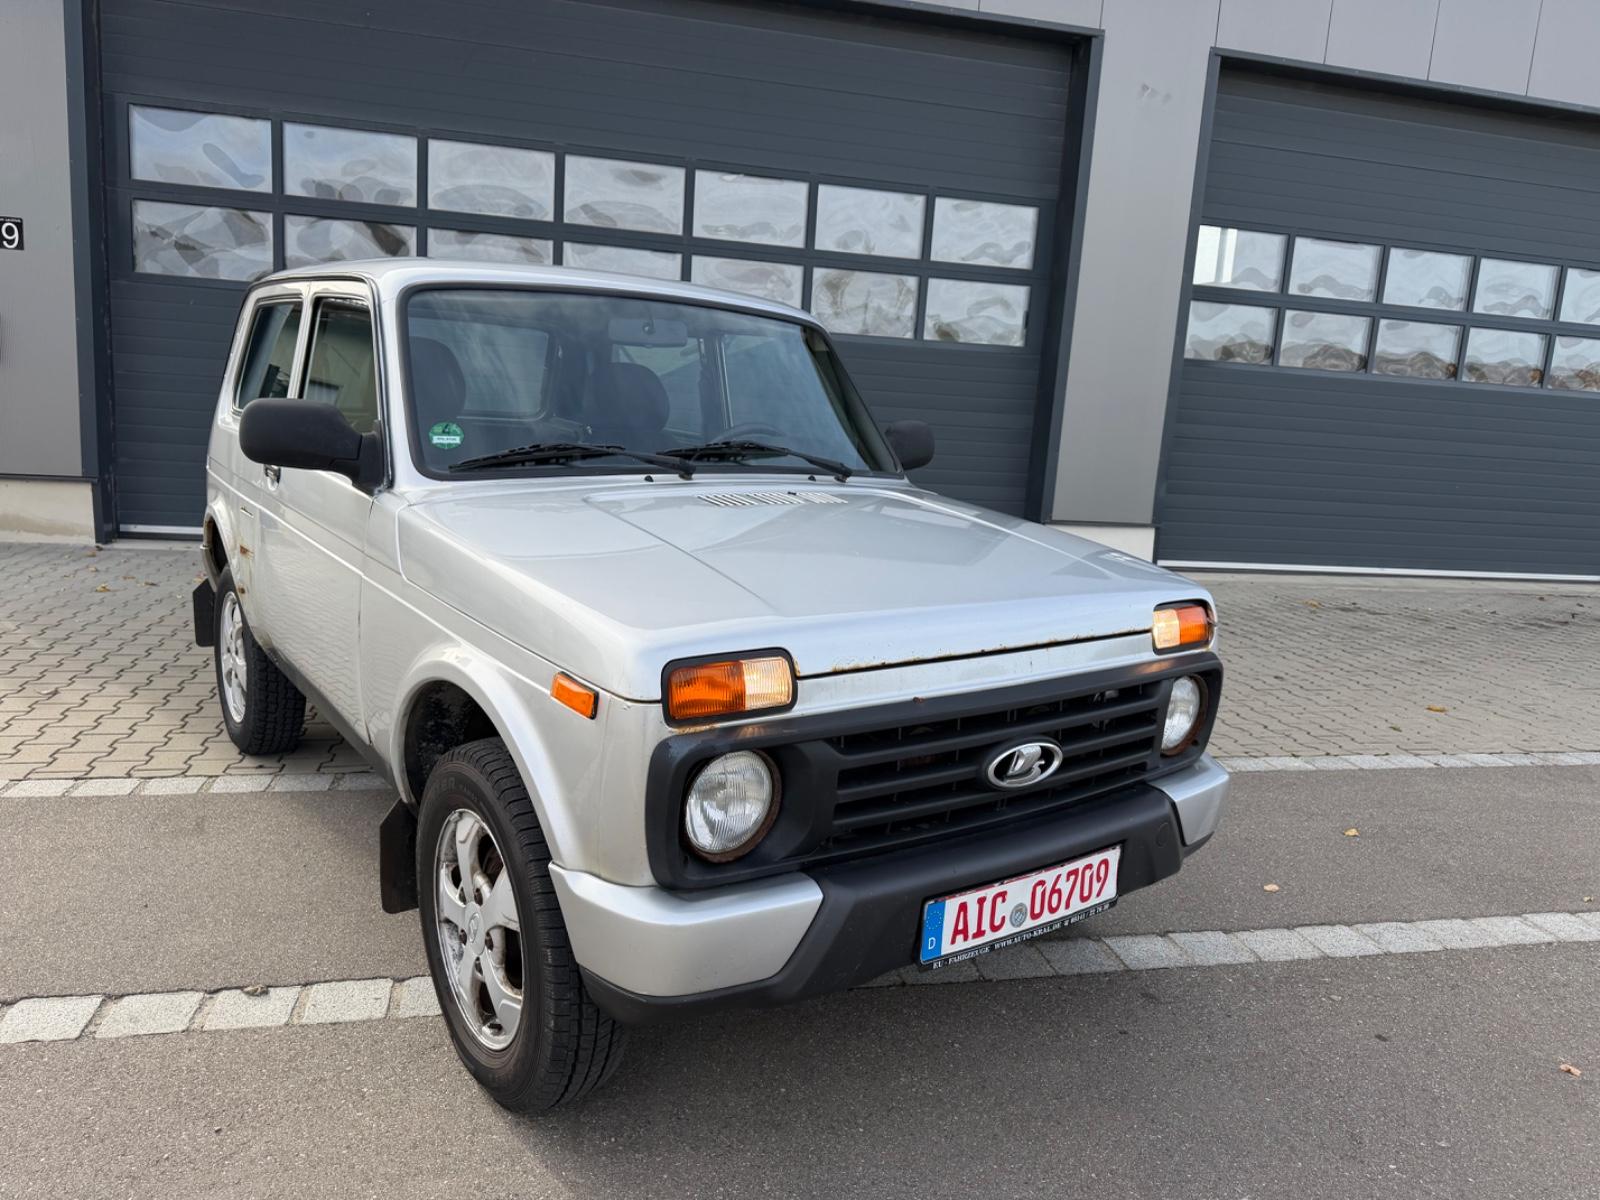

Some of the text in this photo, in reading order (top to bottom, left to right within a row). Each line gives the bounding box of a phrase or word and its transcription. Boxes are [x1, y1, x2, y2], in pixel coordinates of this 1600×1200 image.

[1, 222, 19, 249] 9
[950, 858, 1110, 945] AIC 06709
[928, 937, 936, 950] D
